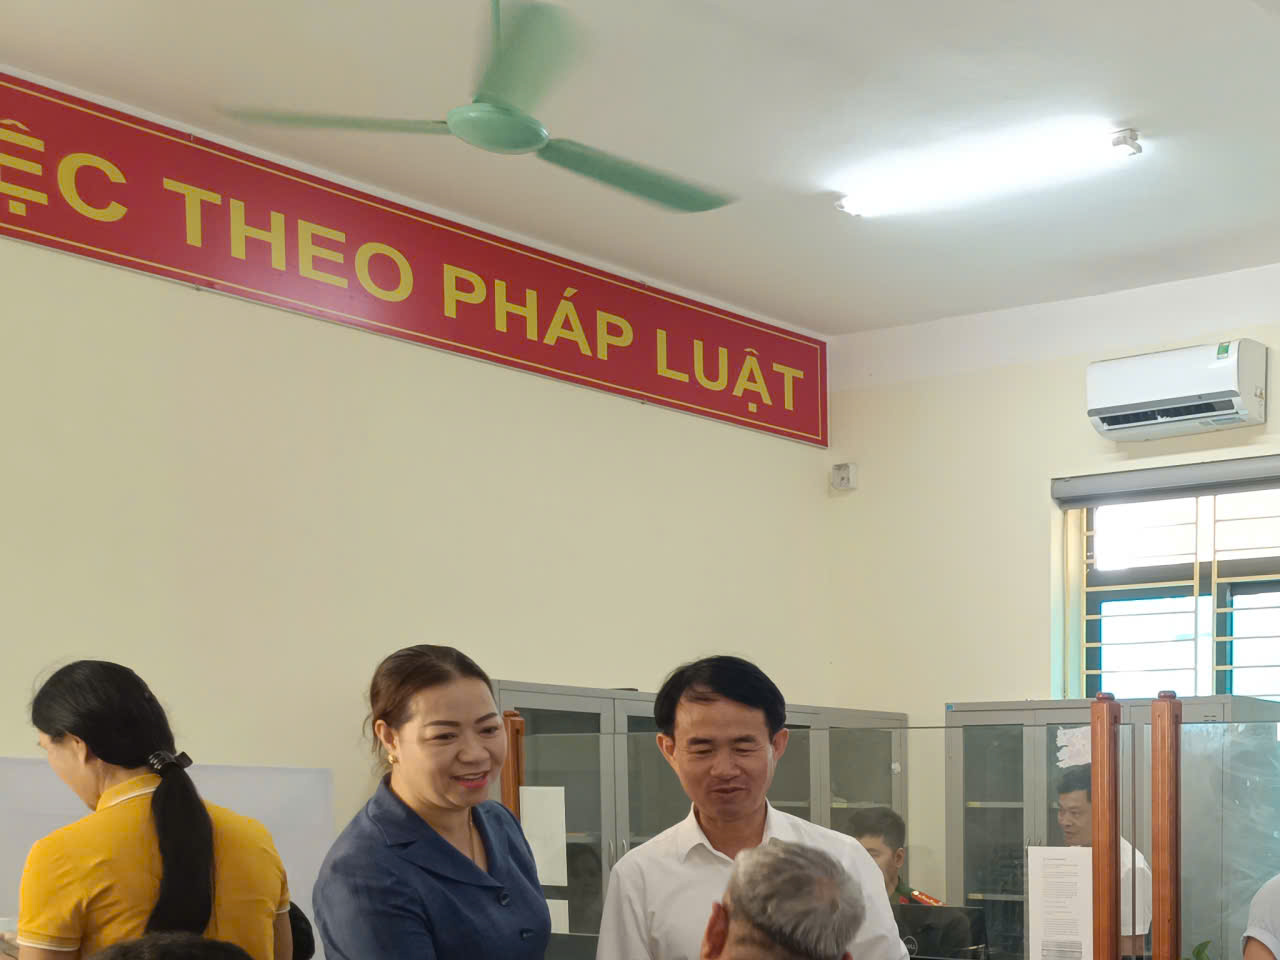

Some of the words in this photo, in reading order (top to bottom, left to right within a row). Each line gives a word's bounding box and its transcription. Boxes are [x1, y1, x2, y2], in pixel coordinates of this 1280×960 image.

[162, 176, 414, 303] THEO
[443, 263, 635, 361] PHÁP
[656, 328, 804, 413] LUẬT
